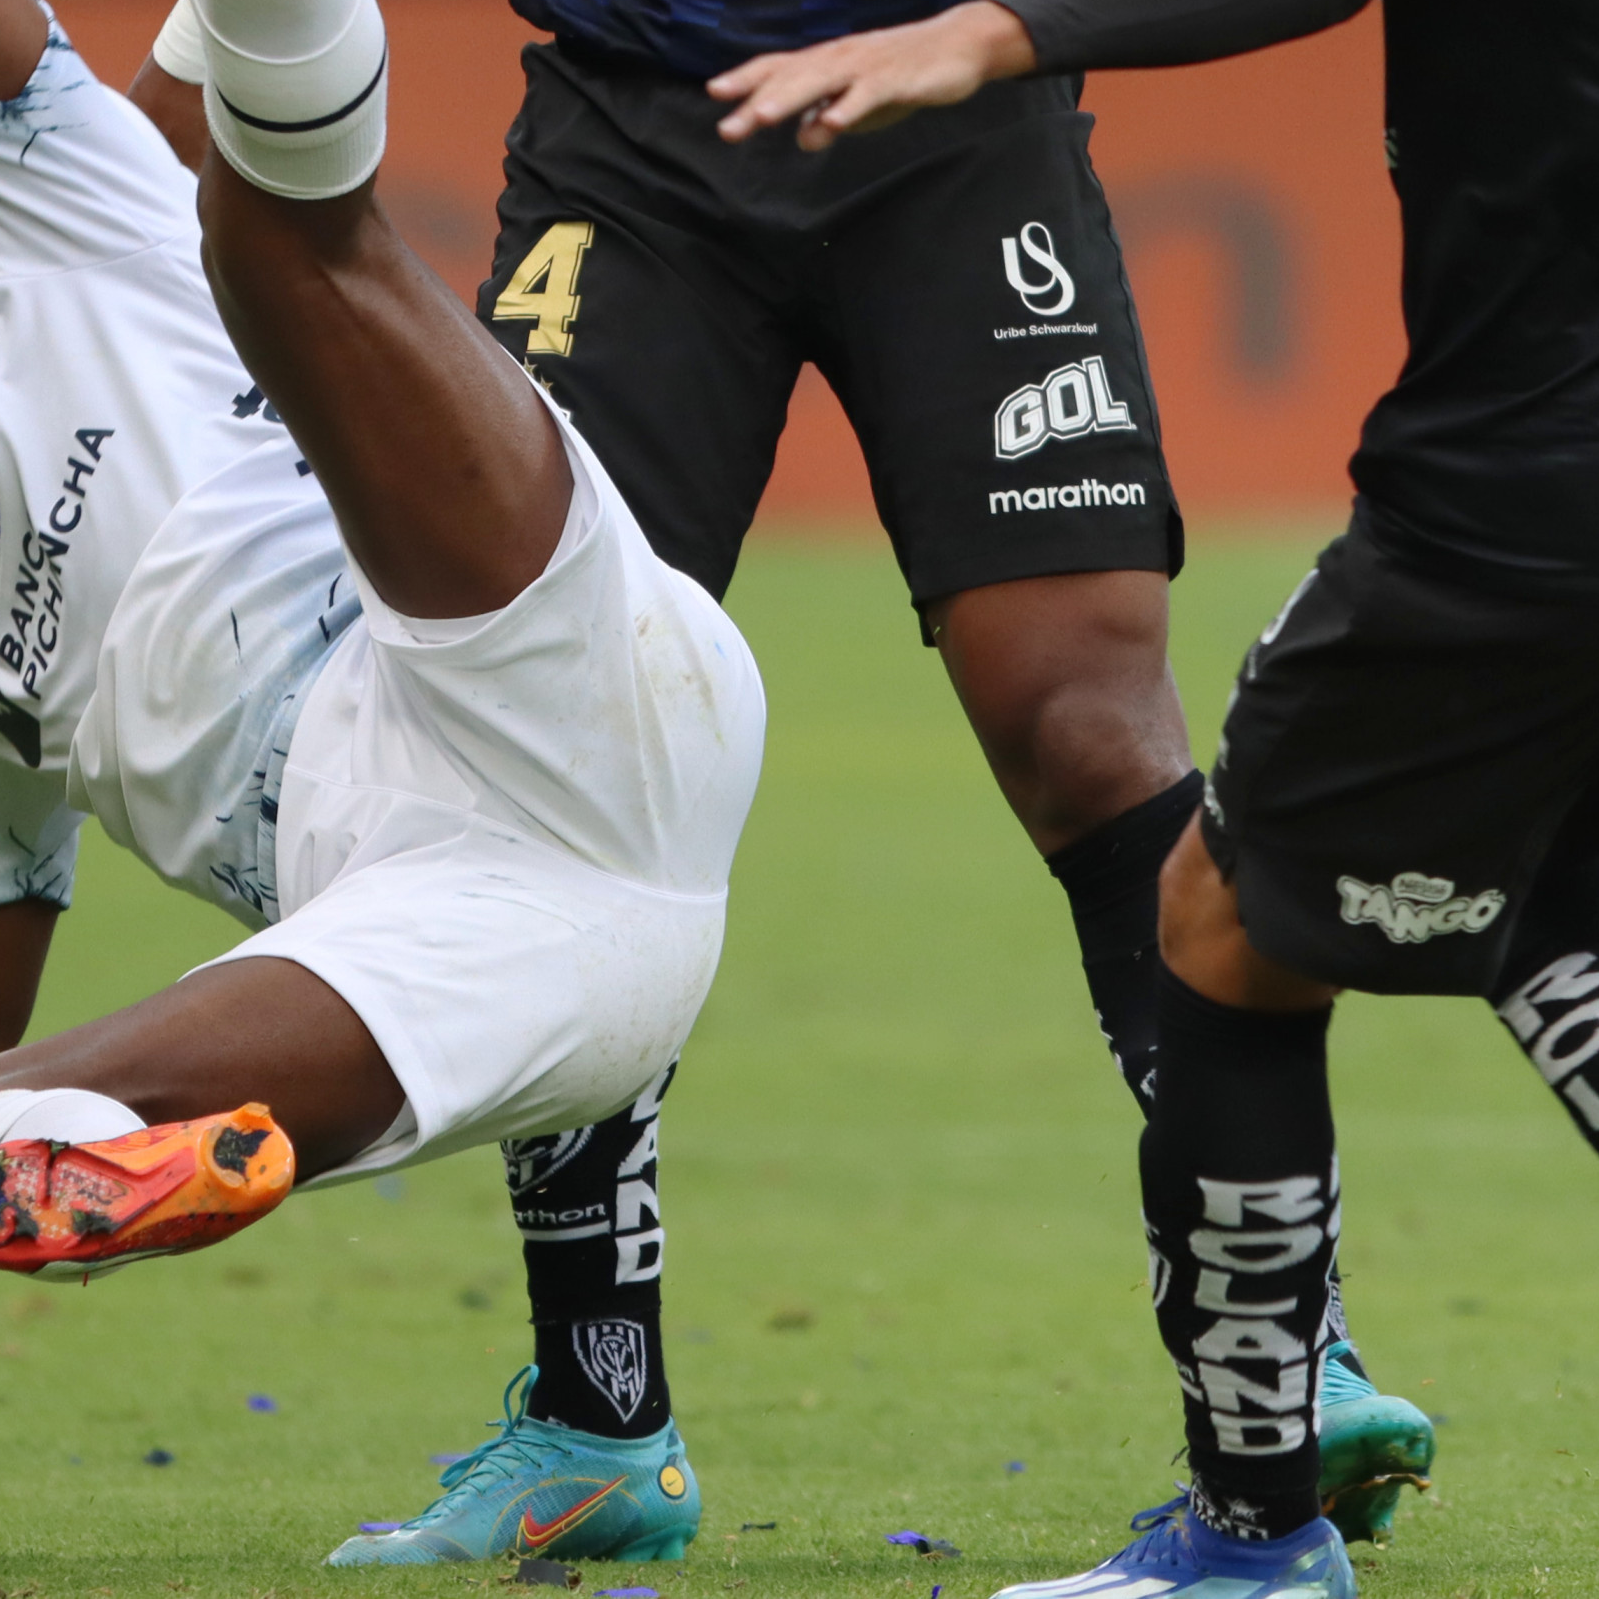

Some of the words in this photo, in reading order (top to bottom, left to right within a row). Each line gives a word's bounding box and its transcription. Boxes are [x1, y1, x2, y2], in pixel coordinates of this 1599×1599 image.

[491, 221, 595, 357] 4
[994, 325, 1027, 340] Uribe
[1028, 322, 1099, 337] Schwarzkopf
[995, 355, 1136, 460] GOL
[988, 478, 1146, 515] marathon
[1187, 1175, 1327, 1457] ROLAND
